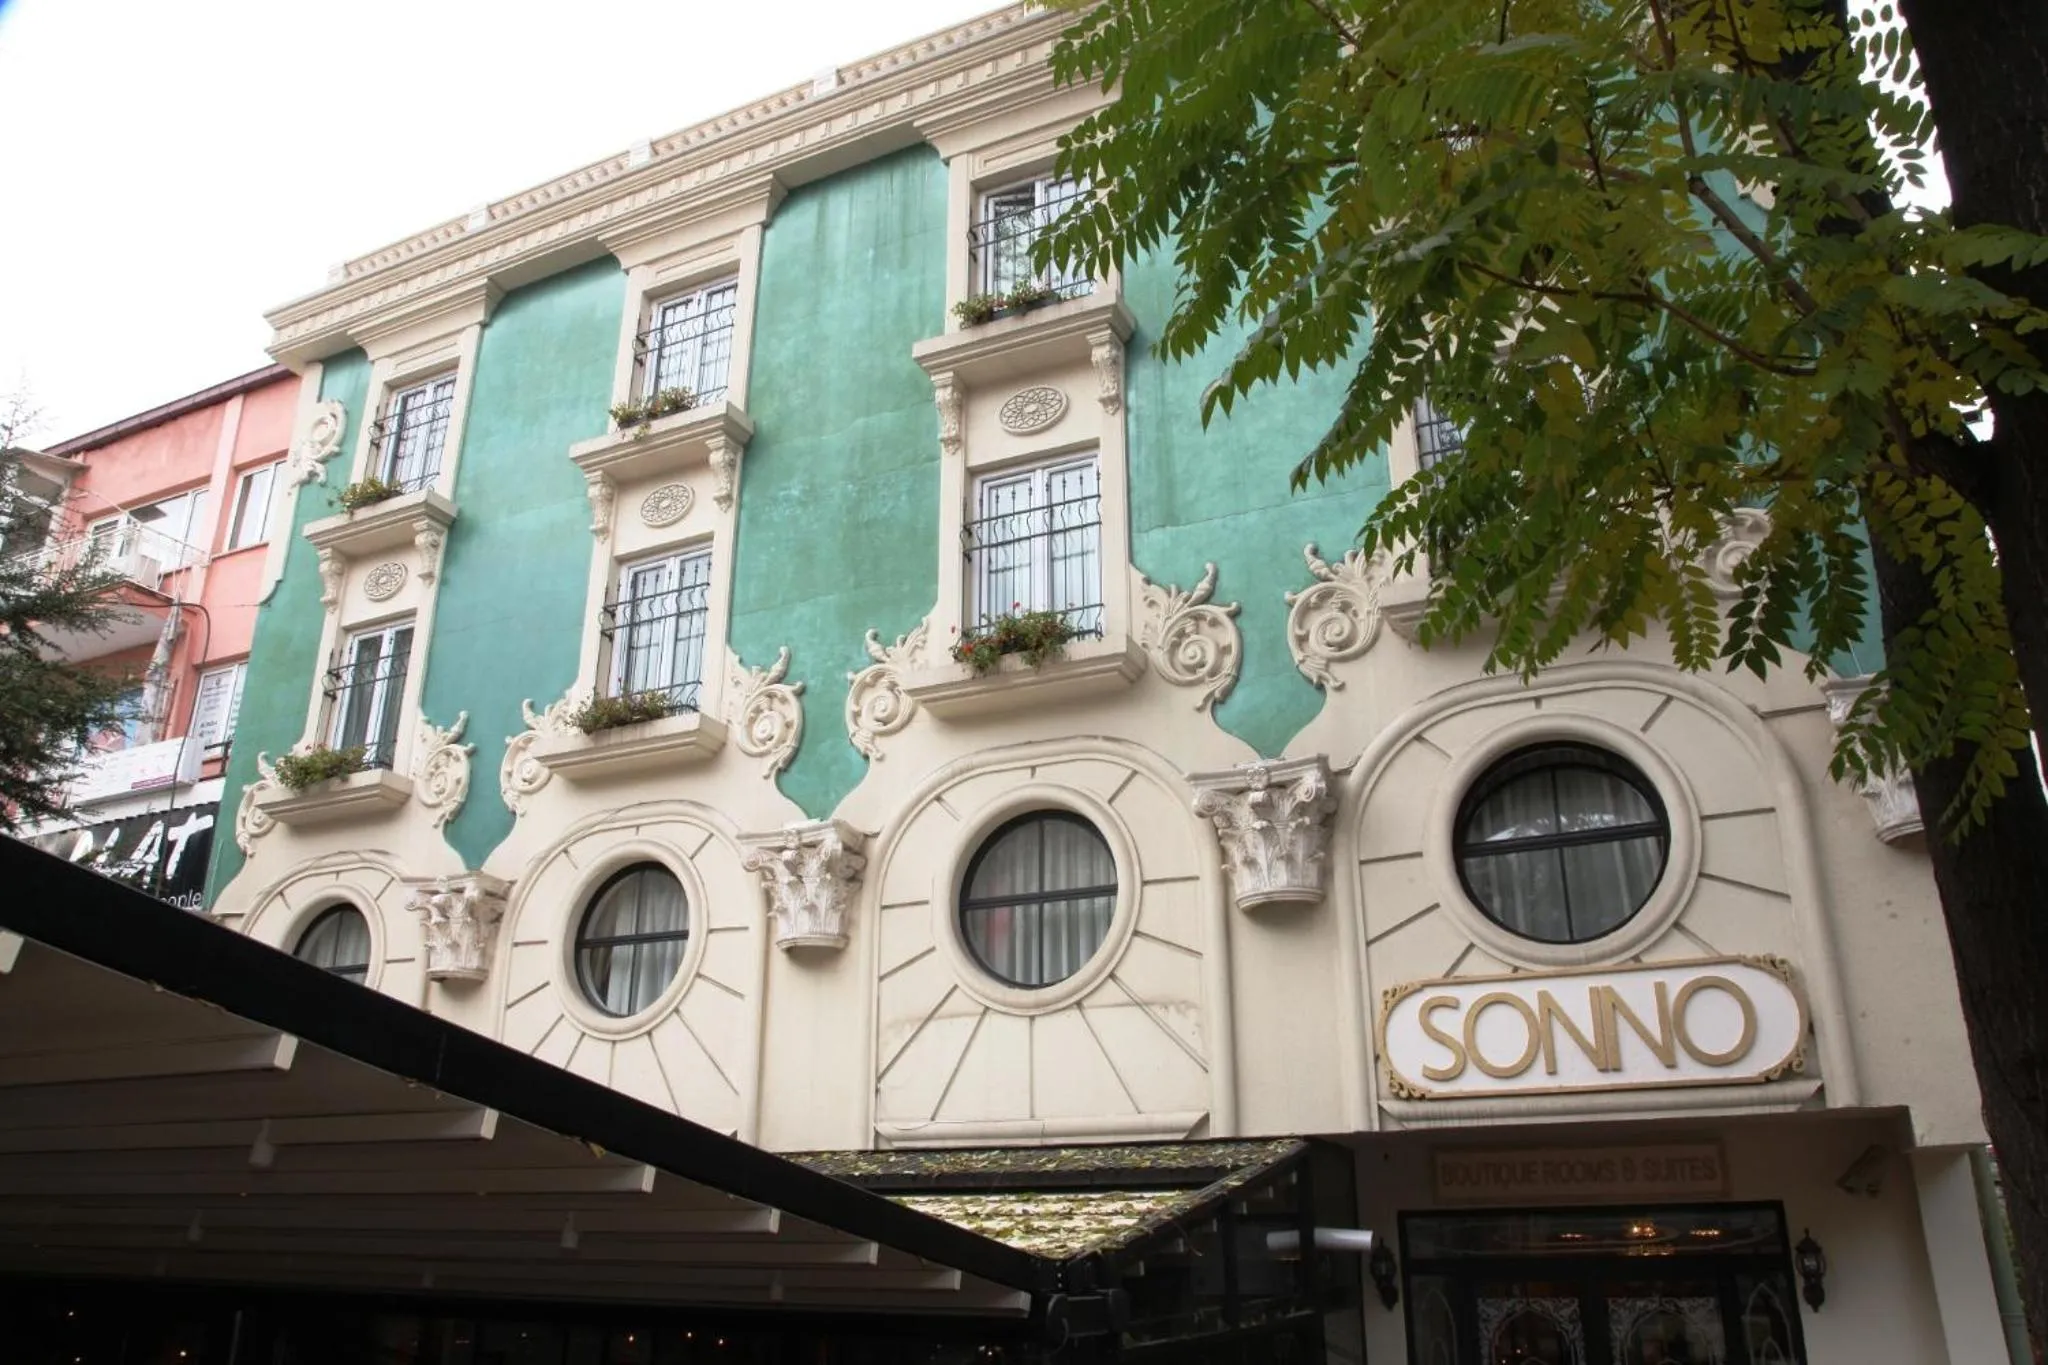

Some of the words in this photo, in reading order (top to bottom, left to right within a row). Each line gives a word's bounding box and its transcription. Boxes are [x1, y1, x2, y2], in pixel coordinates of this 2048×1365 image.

[1418, 974, 1758, 1081] SONNO
[1441, 1160, 1539, 1189] BOUTIQUE
[1541, 1158, 1616, 1185] ROOMS
[1642, 1155, 1718, 1182] SUITES
